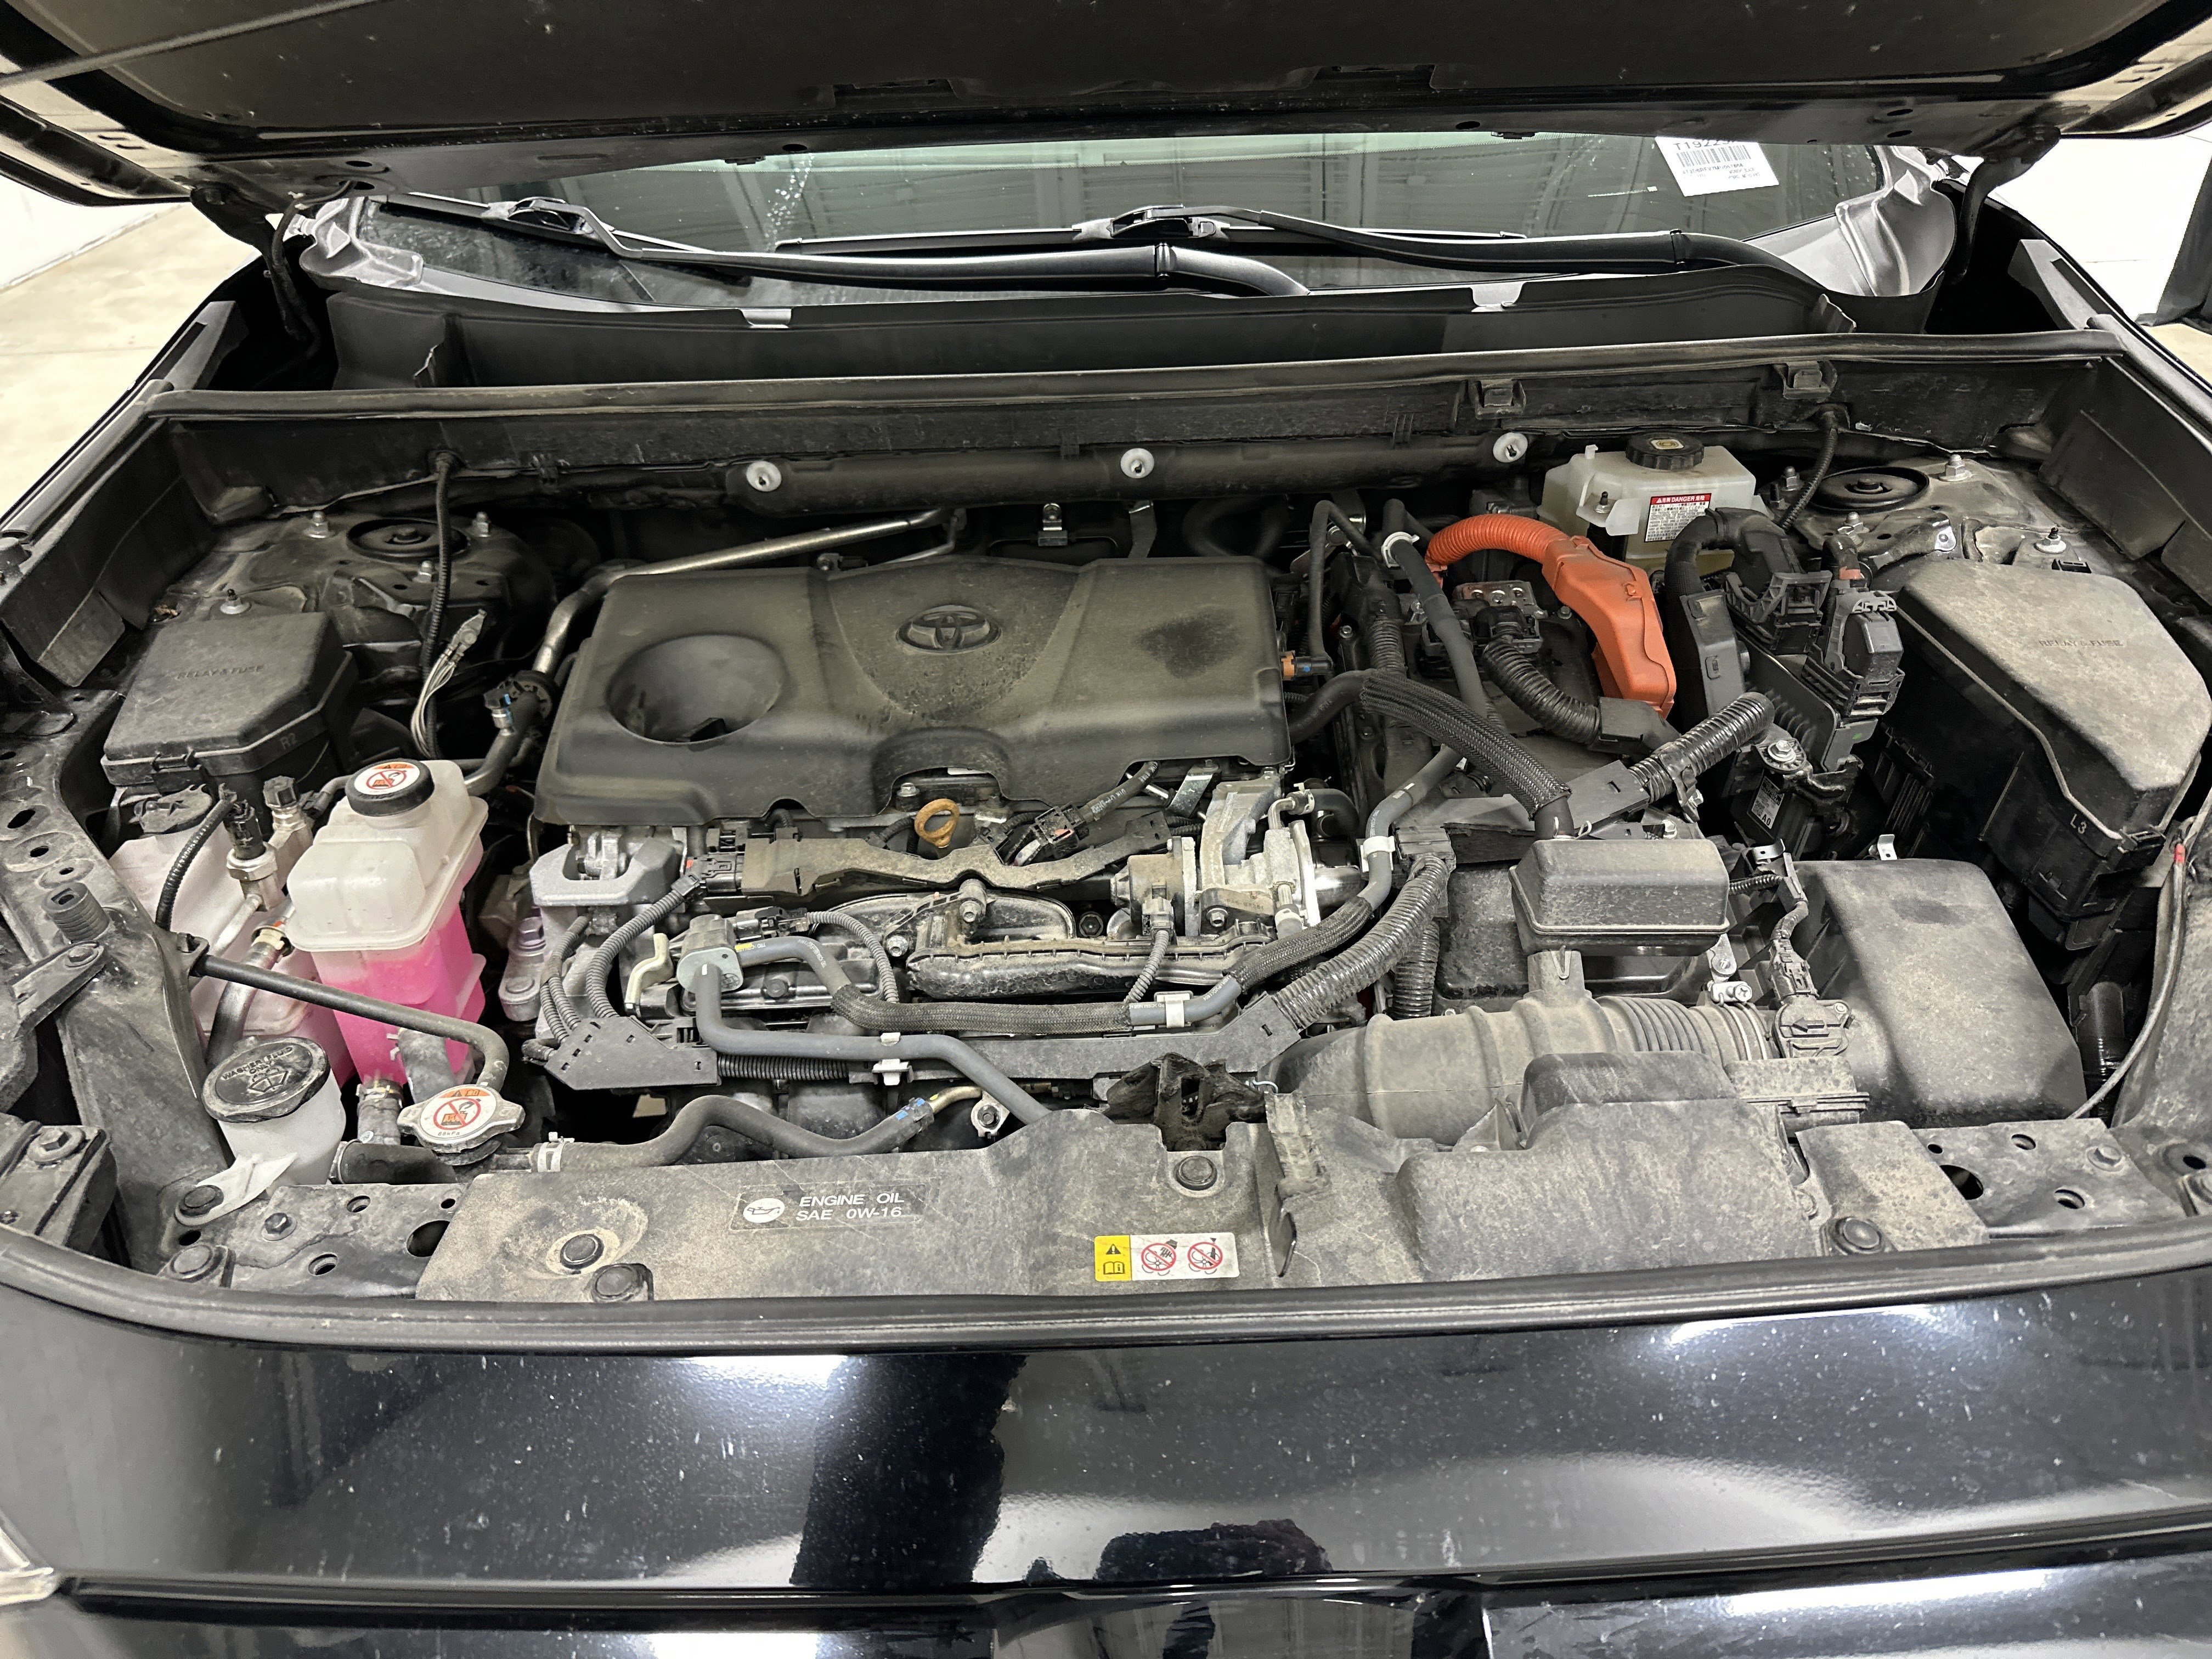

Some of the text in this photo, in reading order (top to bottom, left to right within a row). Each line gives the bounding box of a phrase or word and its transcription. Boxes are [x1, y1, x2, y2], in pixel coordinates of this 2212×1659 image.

[230, 665, 265, 674] FUSE
[2070, 814, 2087, 834] L3
[221, 1059, 263, 1080] WASHER
[799, 1192, 905, 1207] ENGINE OIL
[795, 1207, 902, 1221] SAE 0W-16
